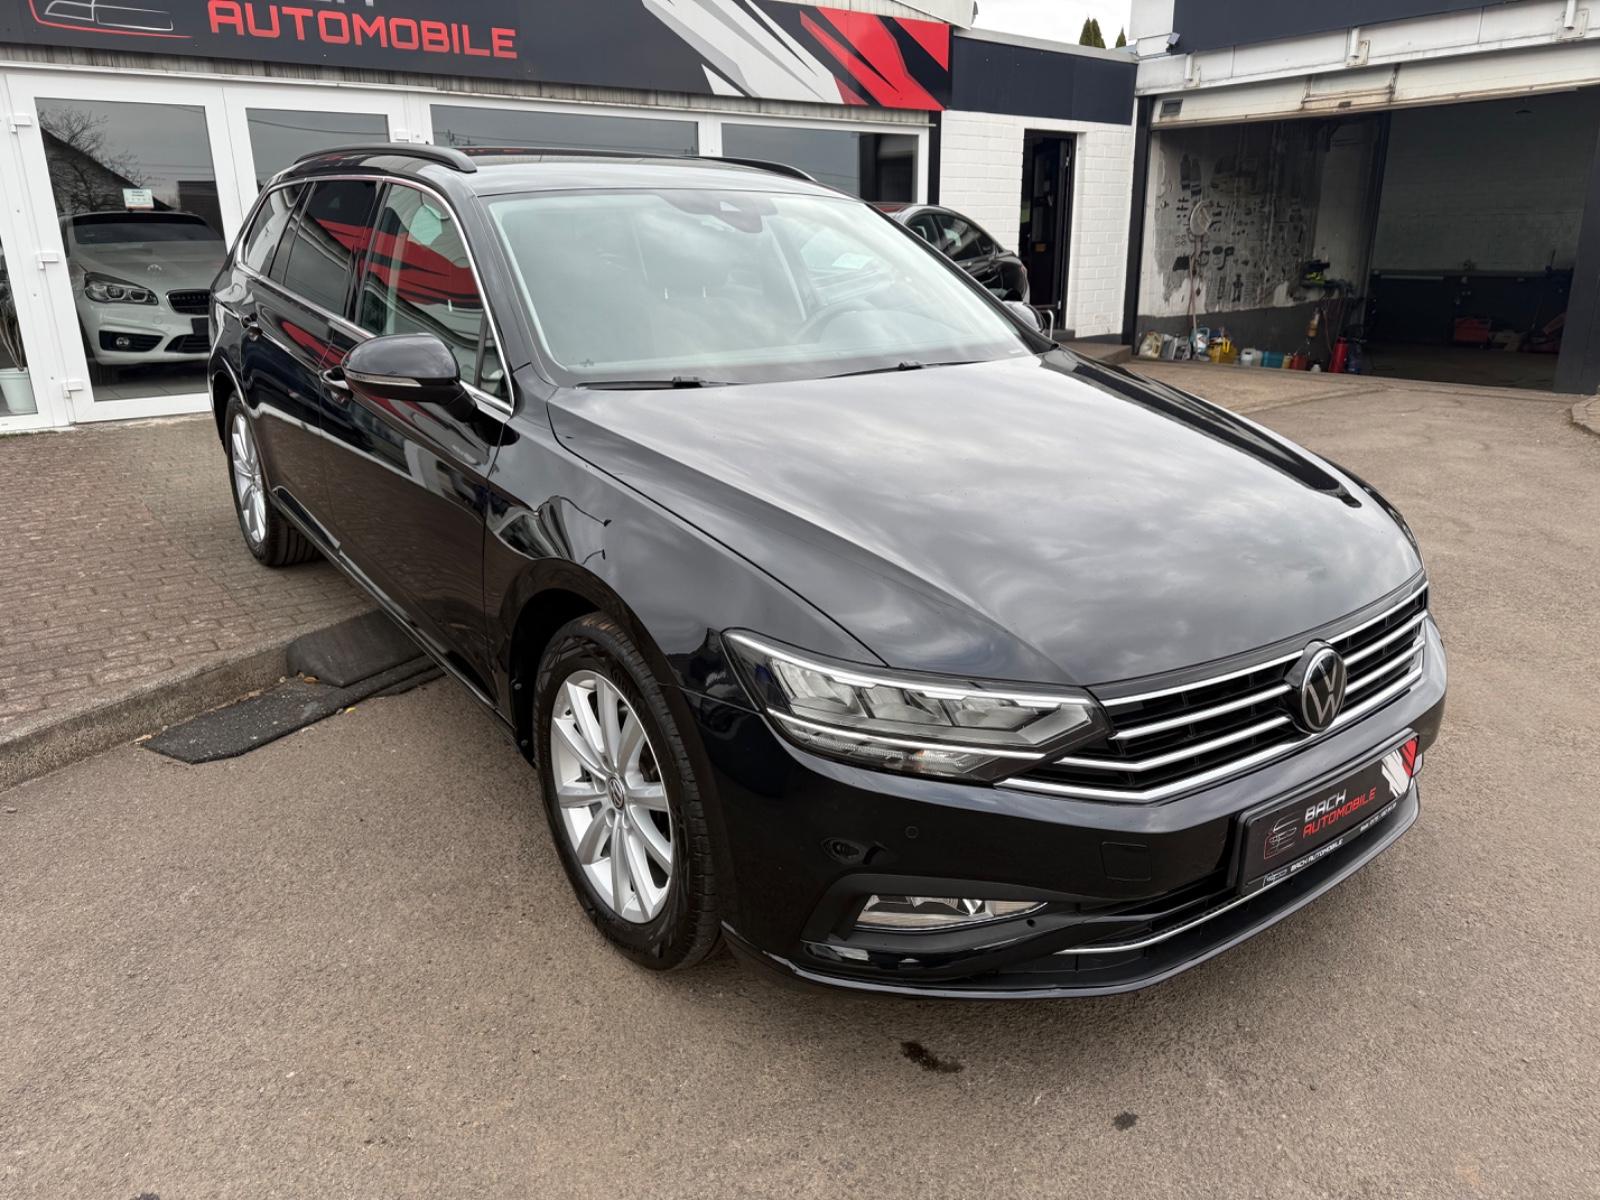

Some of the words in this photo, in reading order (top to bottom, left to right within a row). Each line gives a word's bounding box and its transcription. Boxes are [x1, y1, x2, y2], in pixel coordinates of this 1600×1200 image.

[207, 0, 518, 59] AUTOMOBILE
[1302, 786, 1377, 838] AUTOMOBILE
[1304, 788, 1347, 822] BACH
